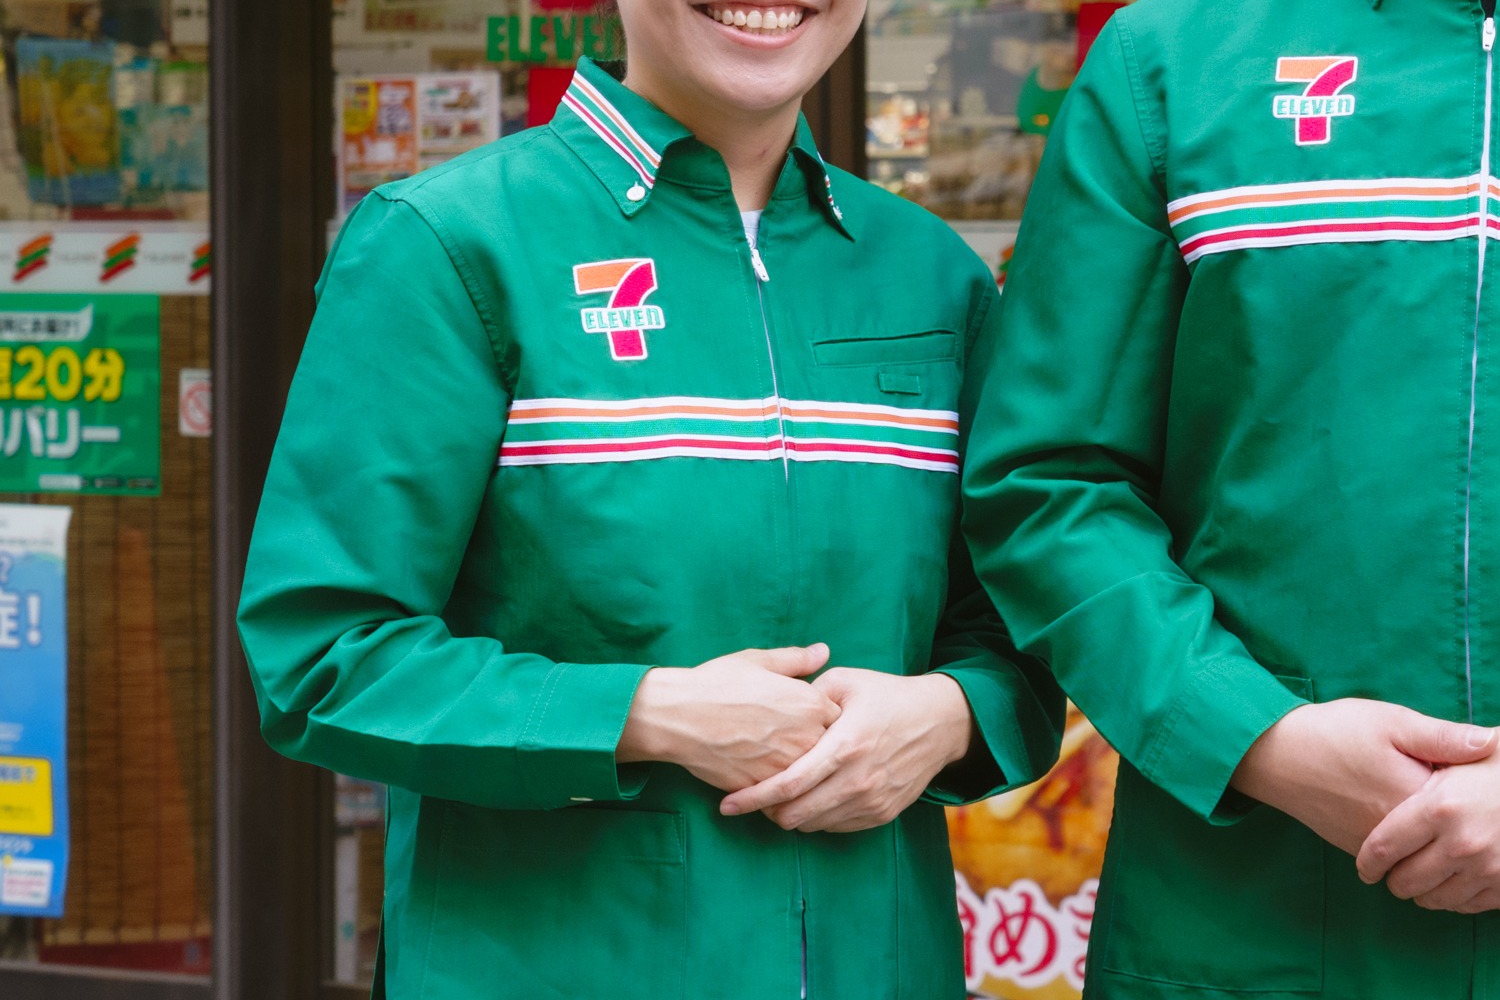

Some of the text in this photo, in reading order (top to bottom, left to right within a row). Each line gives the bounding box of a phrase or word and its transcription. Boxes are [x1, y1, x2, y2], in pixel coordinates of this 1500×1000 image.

[1275, 56, 1358, 145] 7
[573, 258, 658, 360] 7
[0, 406, 121, 458] バリー
